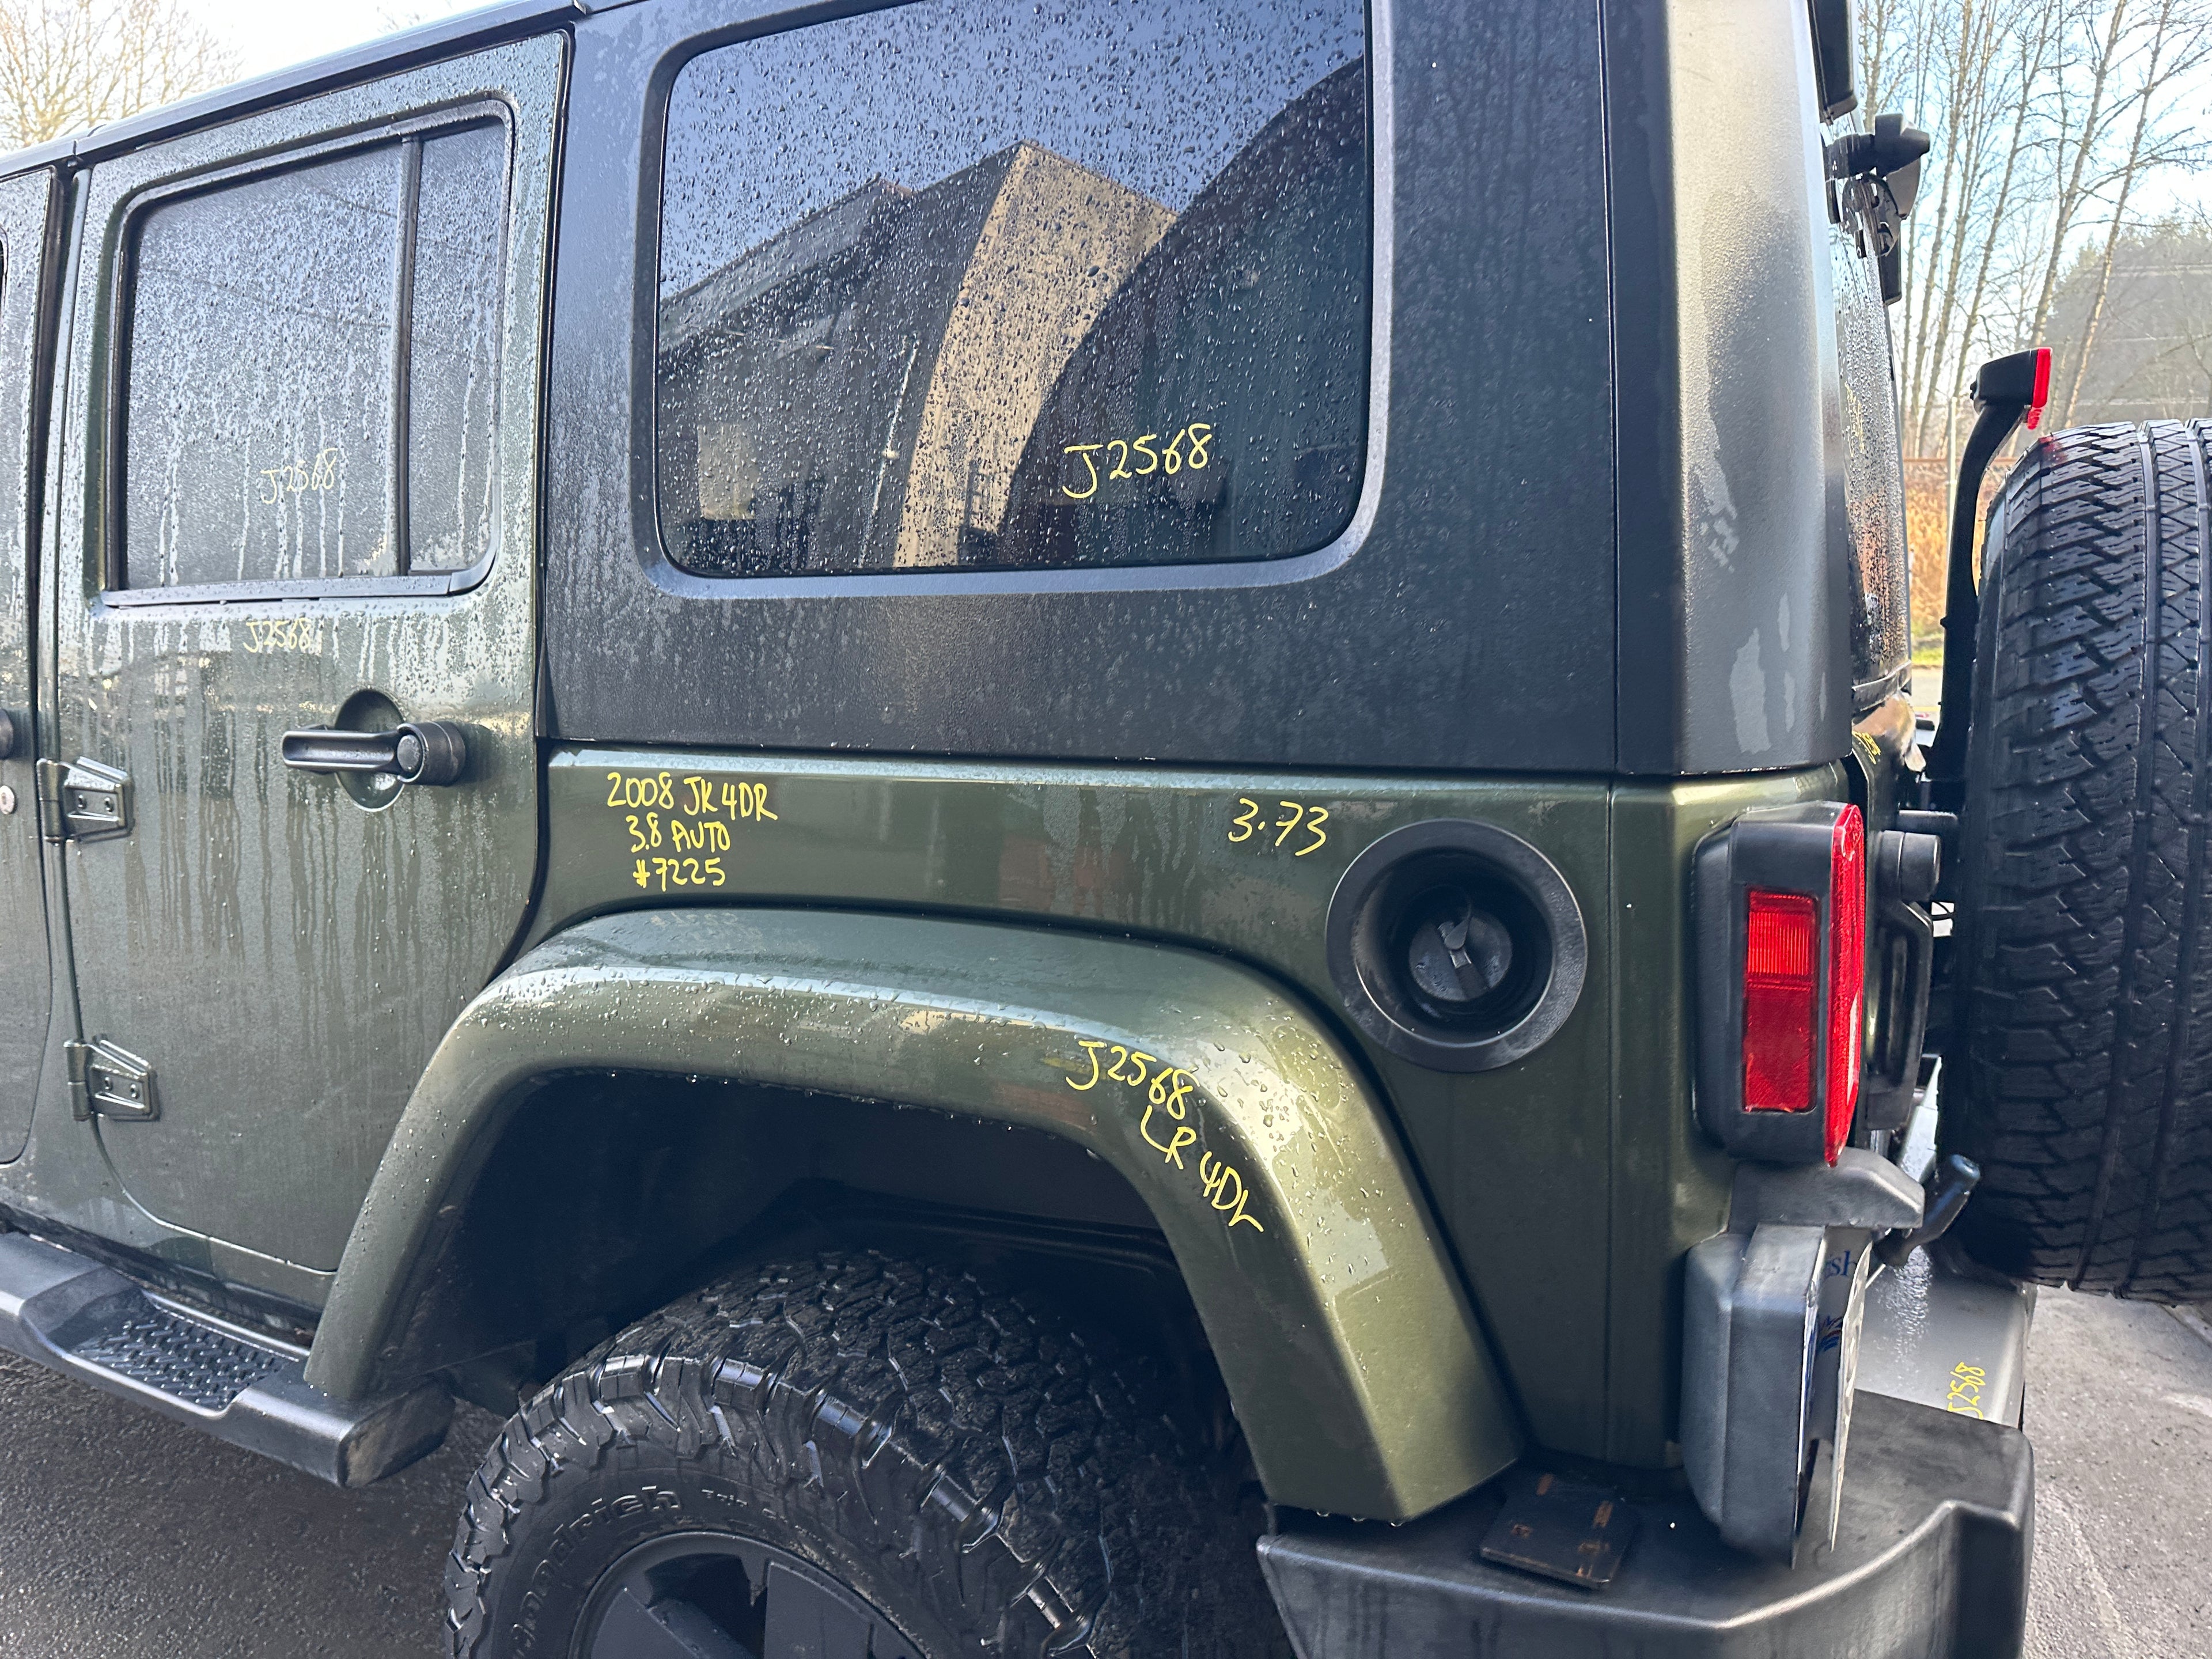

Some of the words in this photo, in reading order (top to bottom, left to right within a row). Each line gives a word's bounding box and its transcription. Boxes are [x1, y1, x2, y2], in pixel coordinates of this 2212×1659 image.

[260, 447, 338, 504] J2568
[1062, 423, 1212, 498] J2568
[243, 618, 311, 653] J2568
[607, 772, 674, 809] 2008
[683, 777, 718, 816] JK
[722, 782, 778, 821] 4DR
[626, 812, 662, 853] 3.8
[671, 820, 730, 853] AUTO
[1228, 798, 1329, 856] 3.73
[632, 857, 725, 891] #7225
[1066, 1040, 1200, 1120] J2568
[1140, 1105, 1196, 1169] LR
